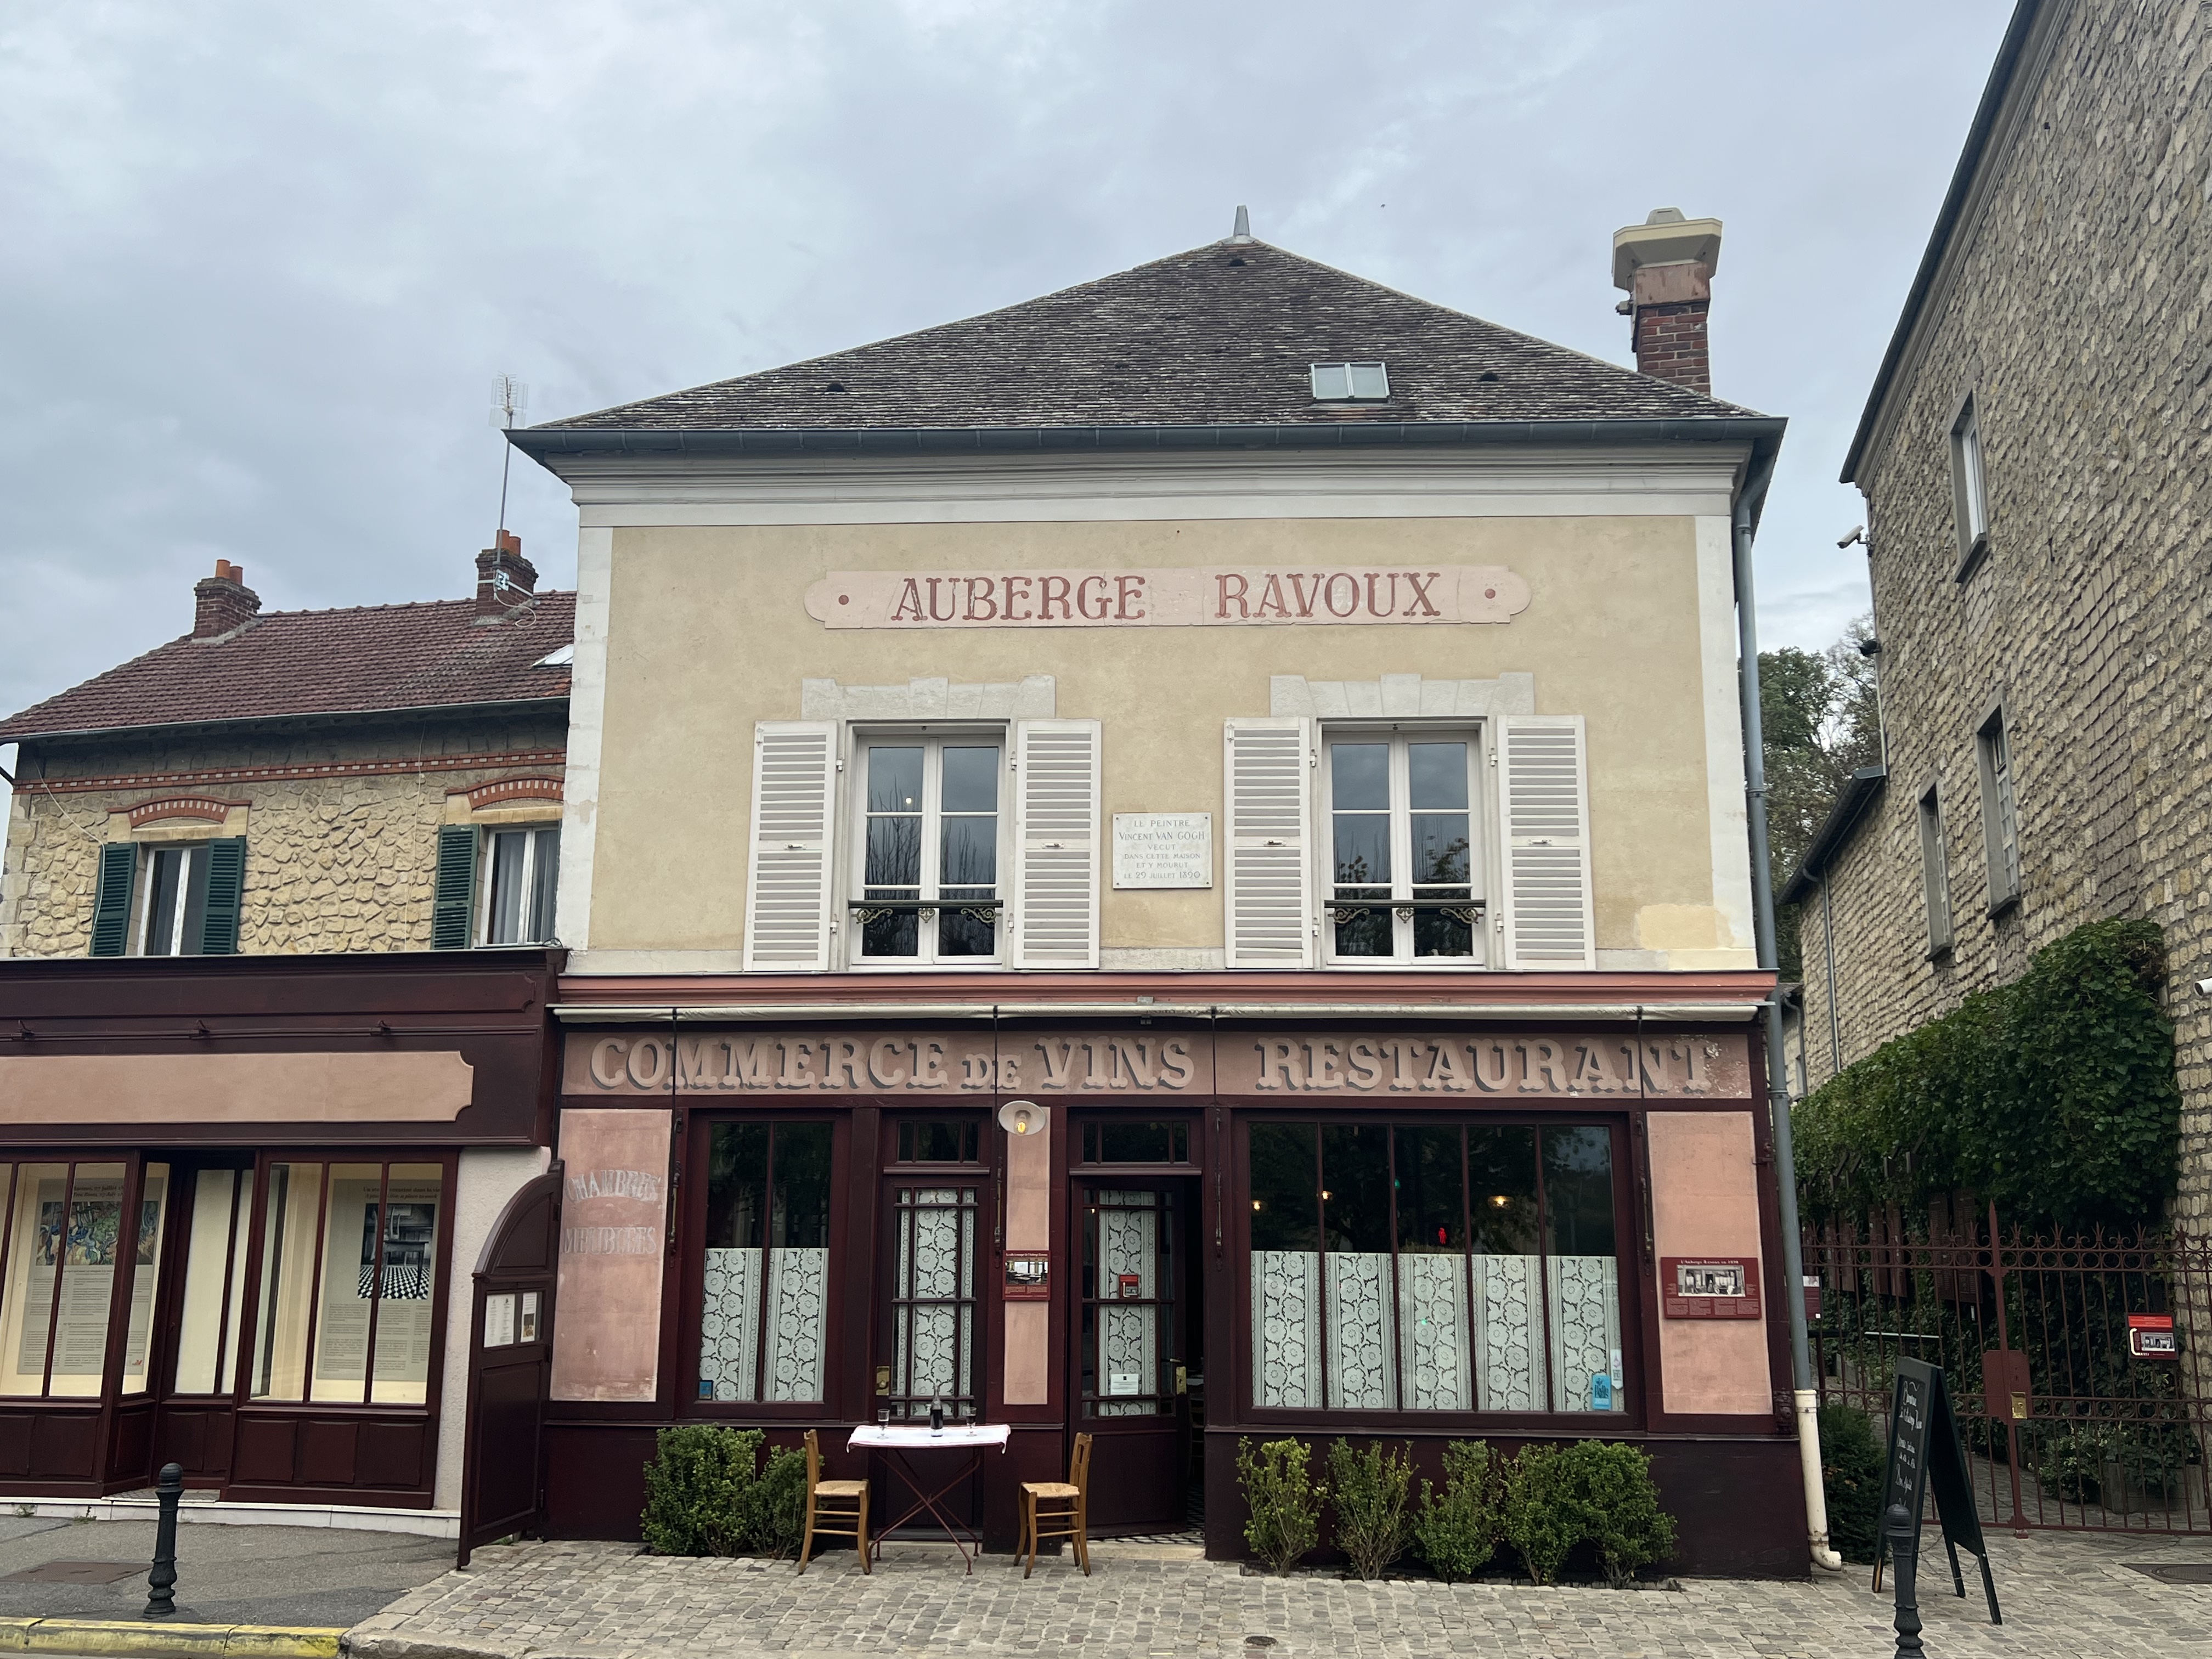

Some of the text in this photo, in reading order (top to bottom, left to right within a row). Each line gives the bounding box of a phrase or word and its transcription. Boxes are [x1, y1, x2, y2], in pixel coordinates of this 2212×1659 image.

[890, 572, 1442, 623] AUBERGE RAVOUX
[1150, 819, 1190, 827] PEINTRE
[1119, 831, 1205, 840] VINCENT VAN GOGH
[1179, 871, 1201, 879] 1890
[590, 1036, 1717, 1094] COMMERCE DE VINS RESTAURANT
